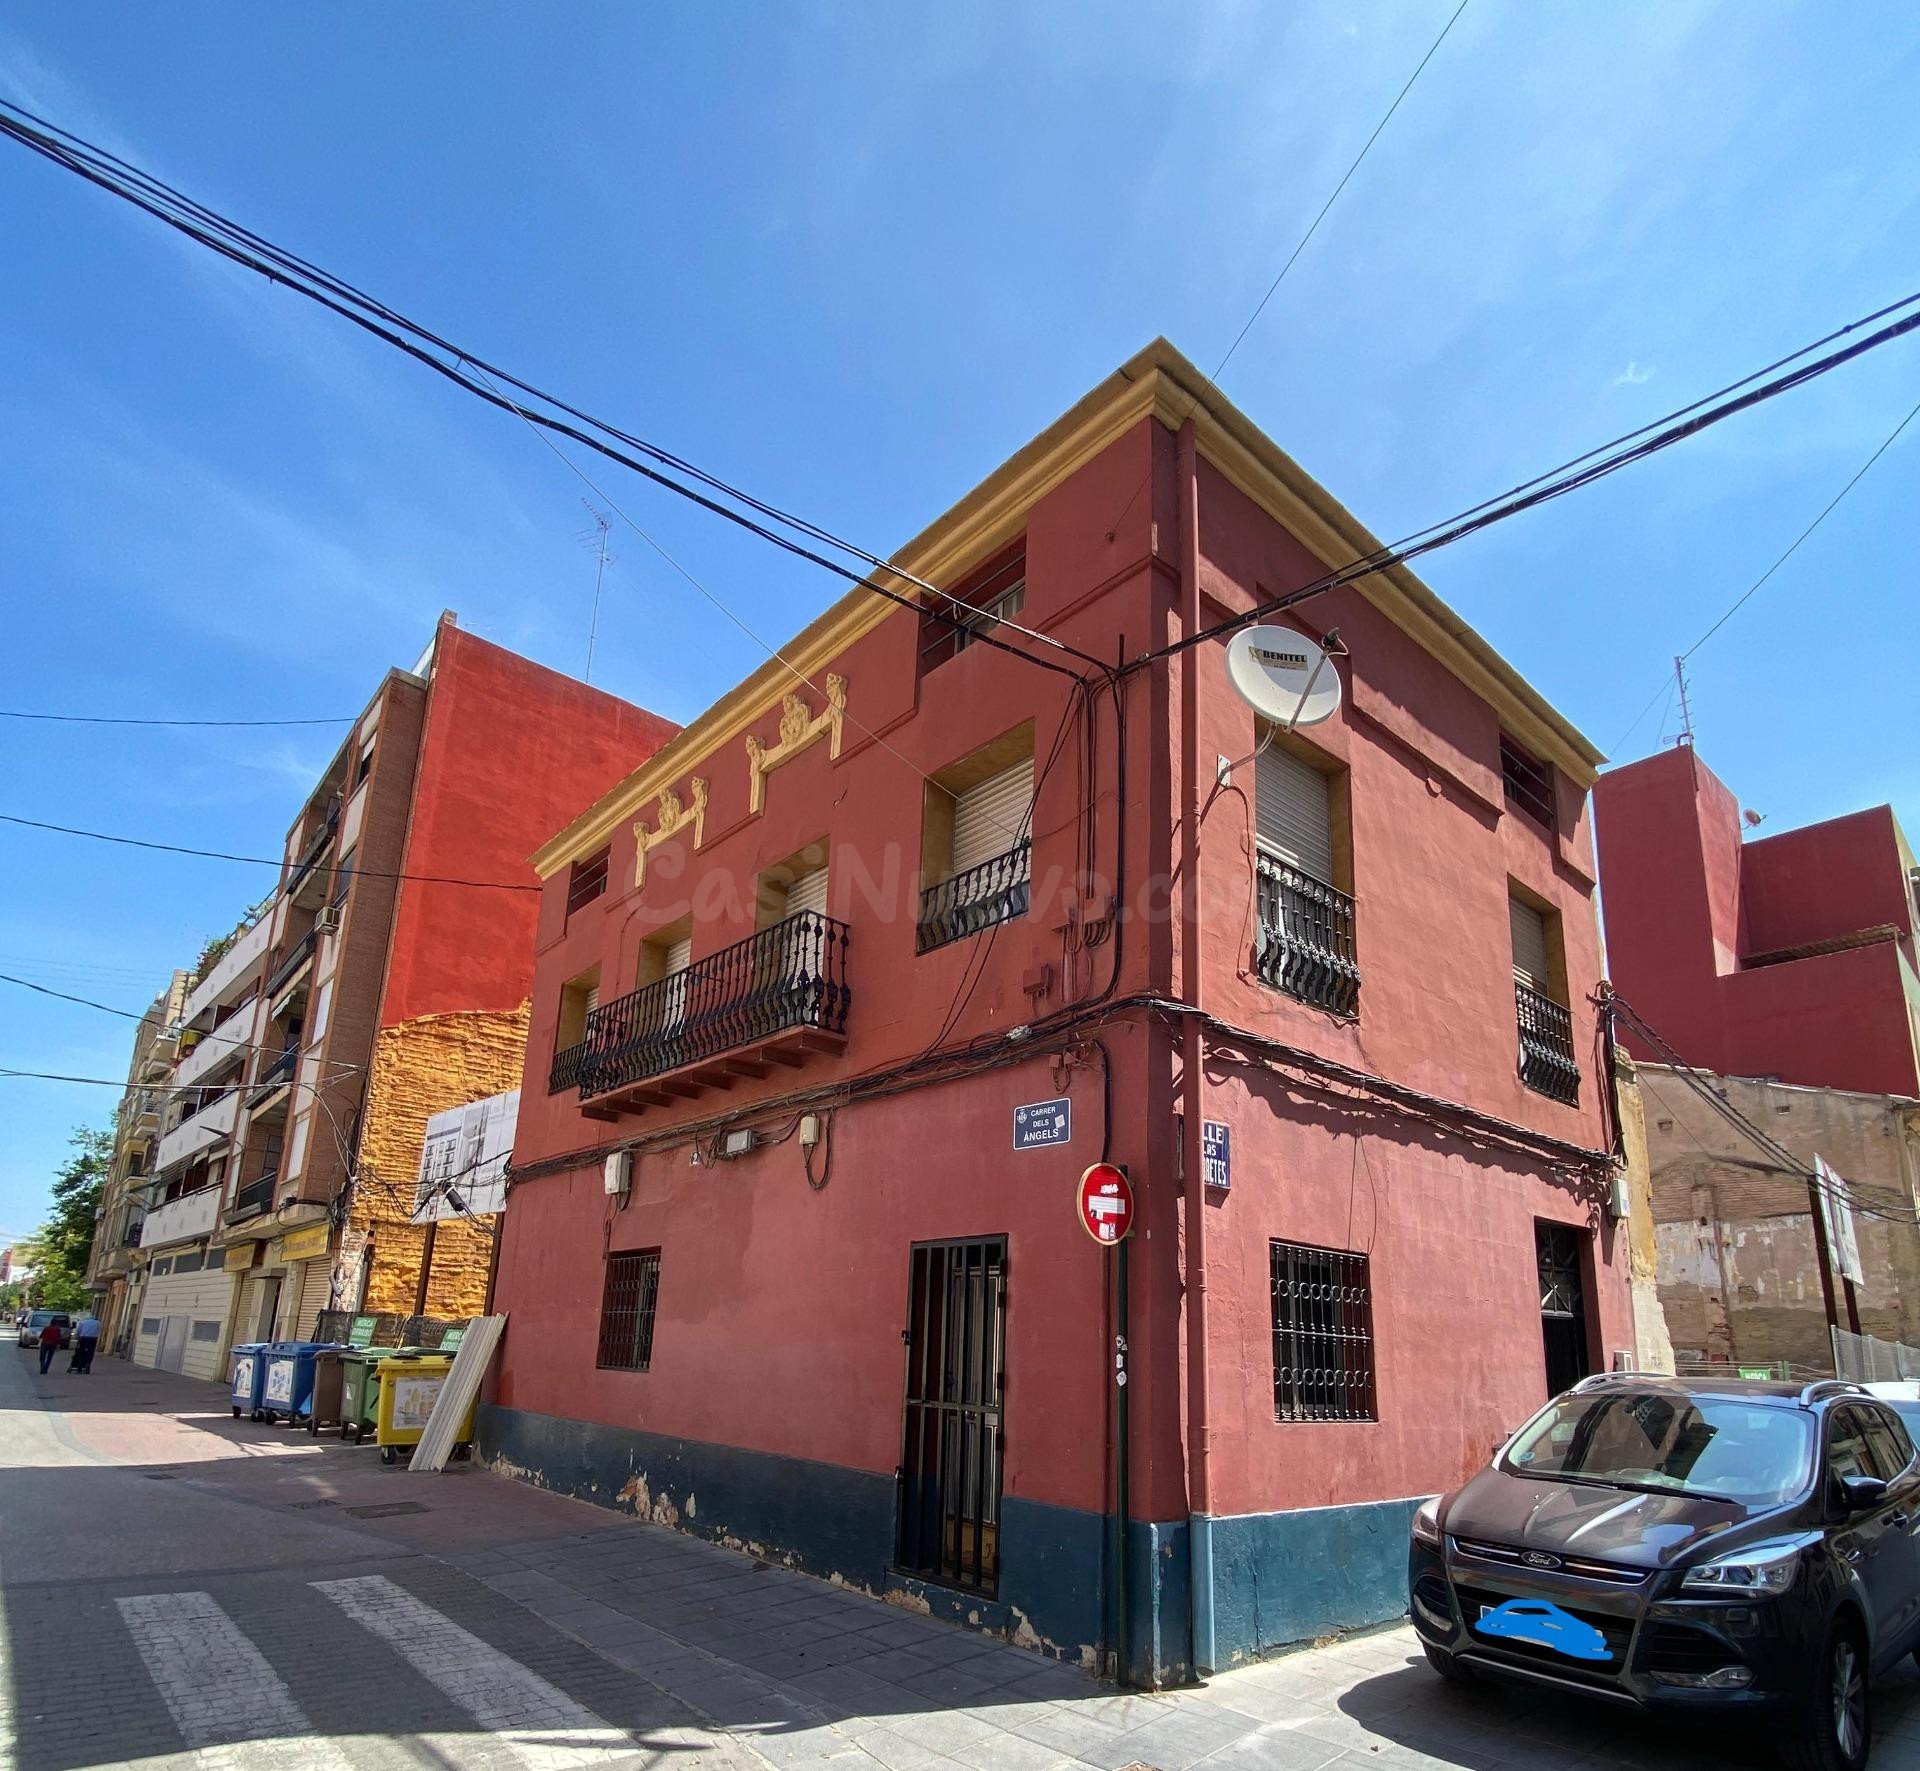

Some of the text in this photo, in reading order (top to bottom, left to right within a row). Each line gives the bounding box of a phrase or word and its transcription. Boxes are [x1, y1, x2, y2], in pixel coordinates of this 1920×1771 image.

[1263, 650, 1307, 662] BENITEL
[1030, 1106, 1056, 1117] CARRER
[1032, 1118, 1050, 1128] DELS
[1528, 1552, 1551, 1565] Ford
